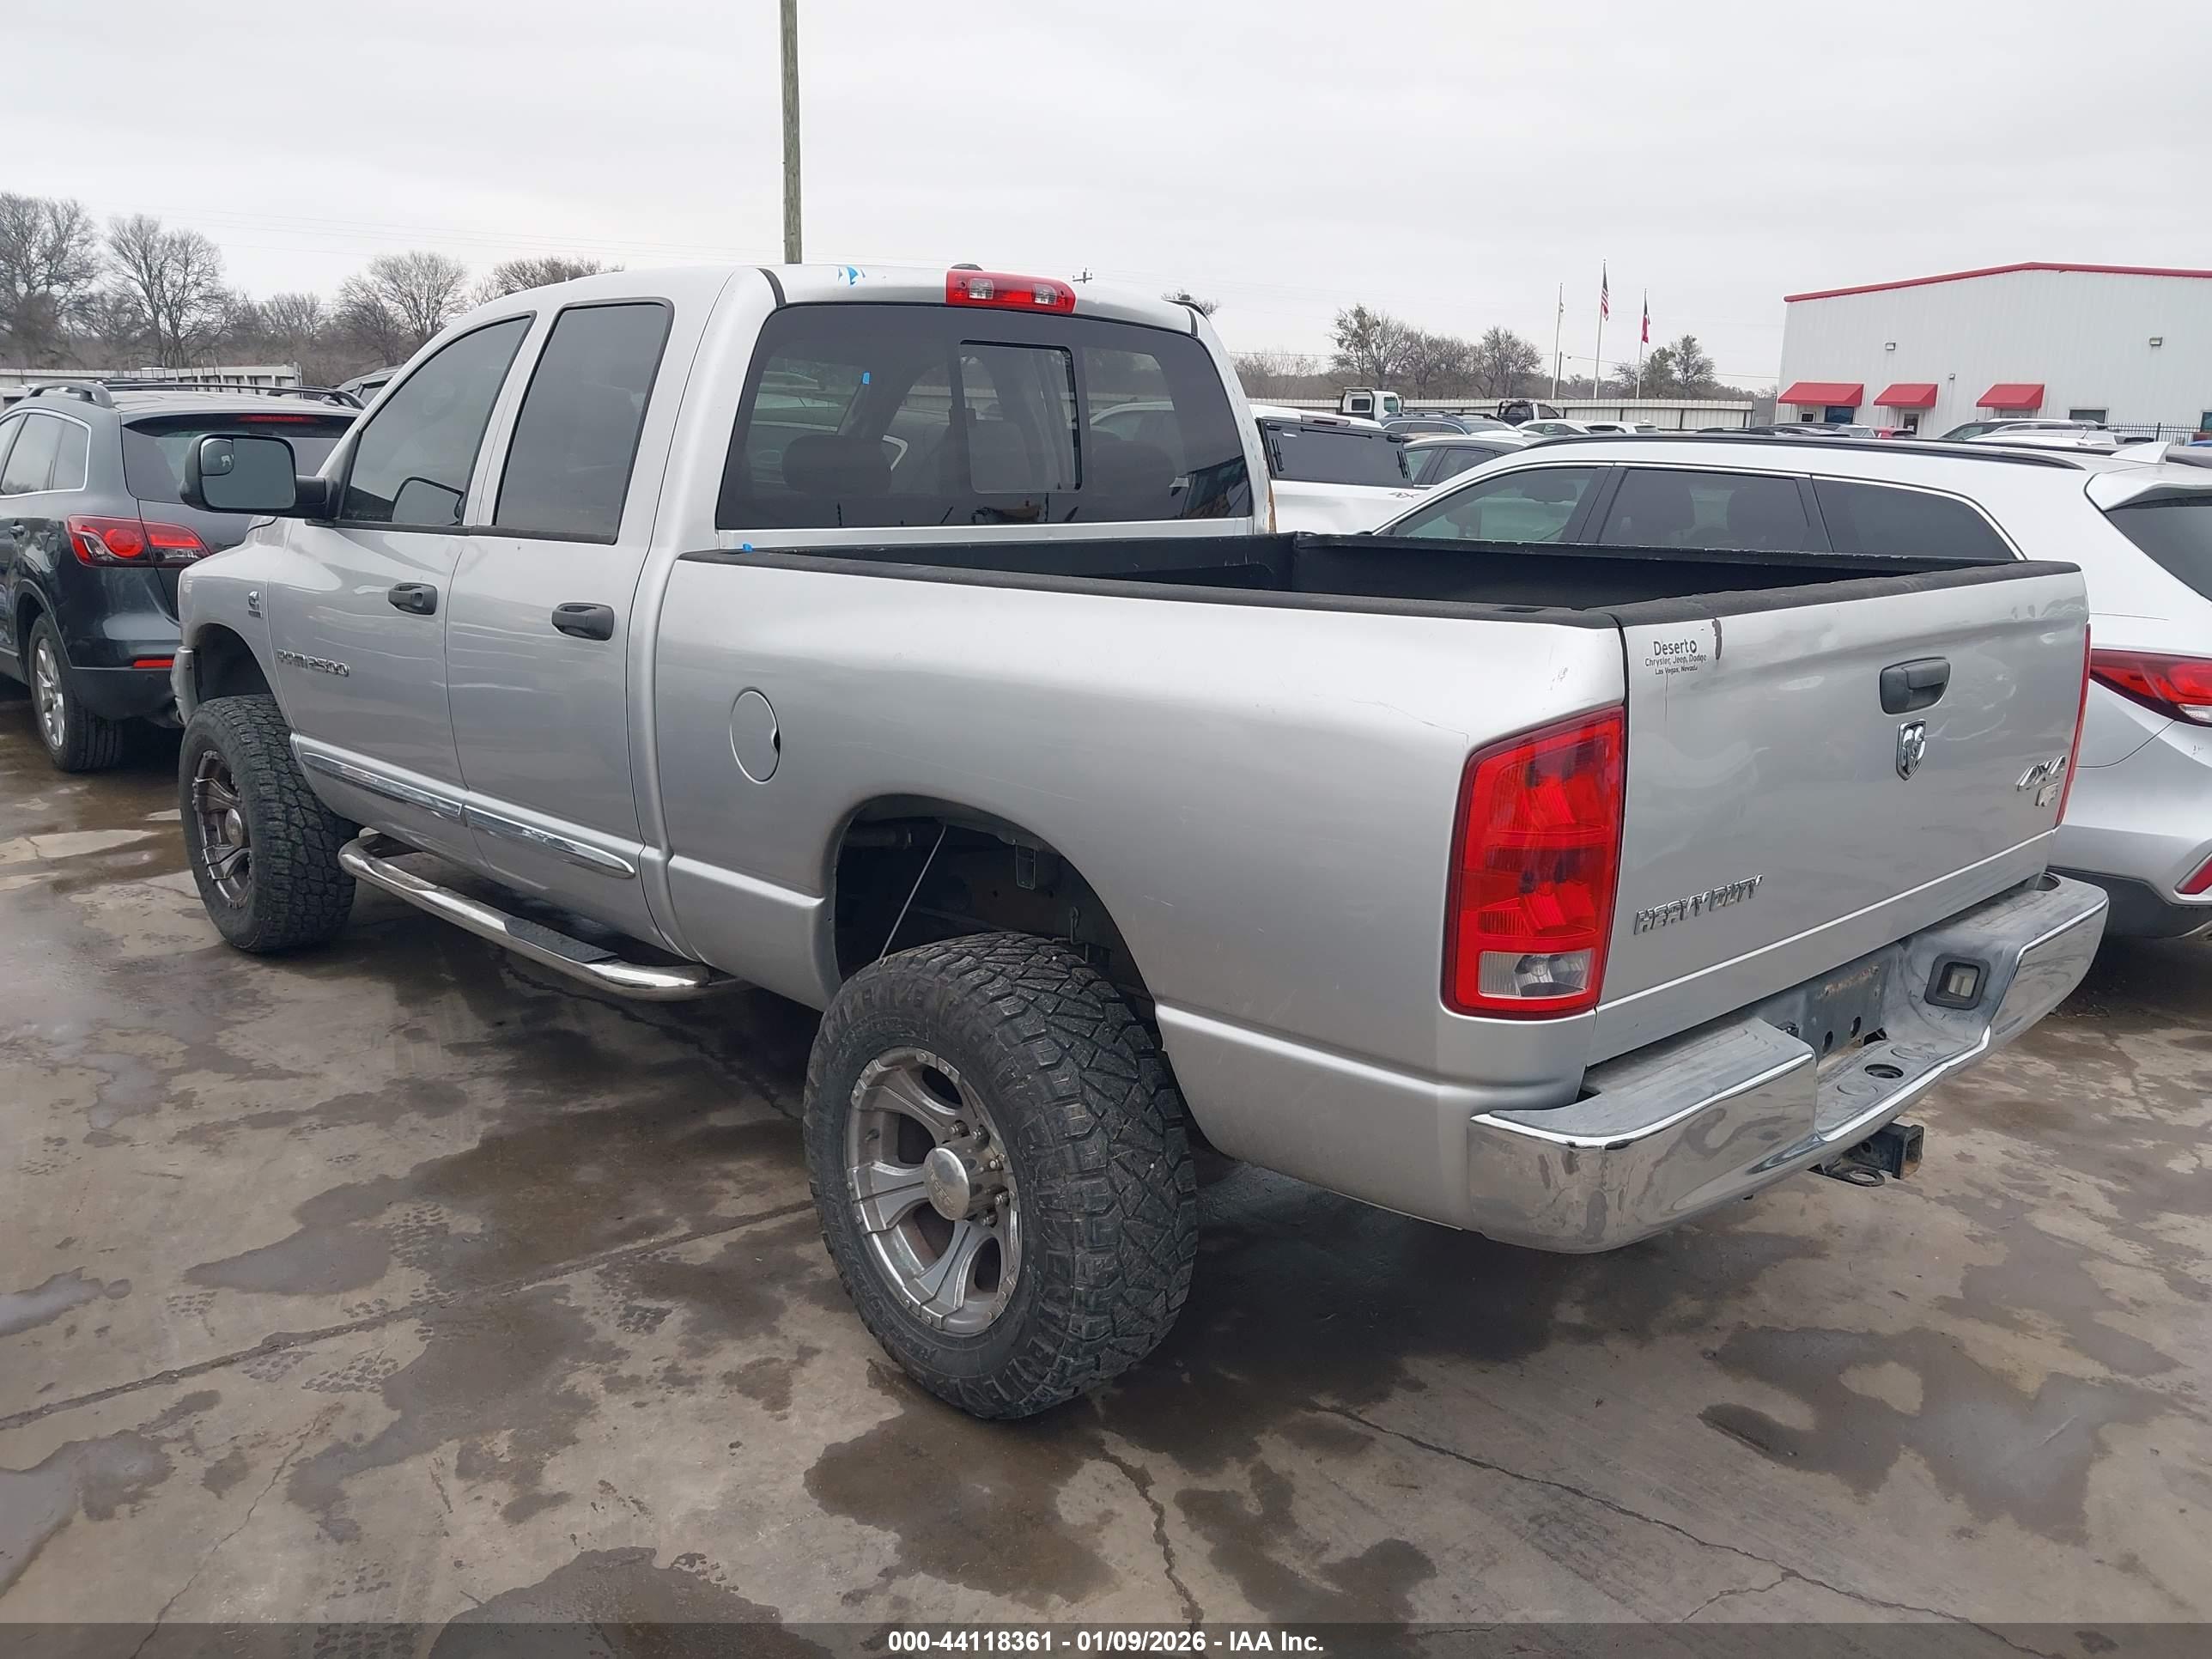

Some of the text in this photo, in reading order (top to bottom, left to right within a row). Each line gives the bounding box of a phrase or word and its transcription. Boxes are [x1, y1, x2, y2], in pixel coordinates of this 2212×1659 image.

[308, 655, 350, 678] 2500
[1689, 653, 1707, 663] Dodge
[1633, 873, 1765, 935] HEAVY DUTY
